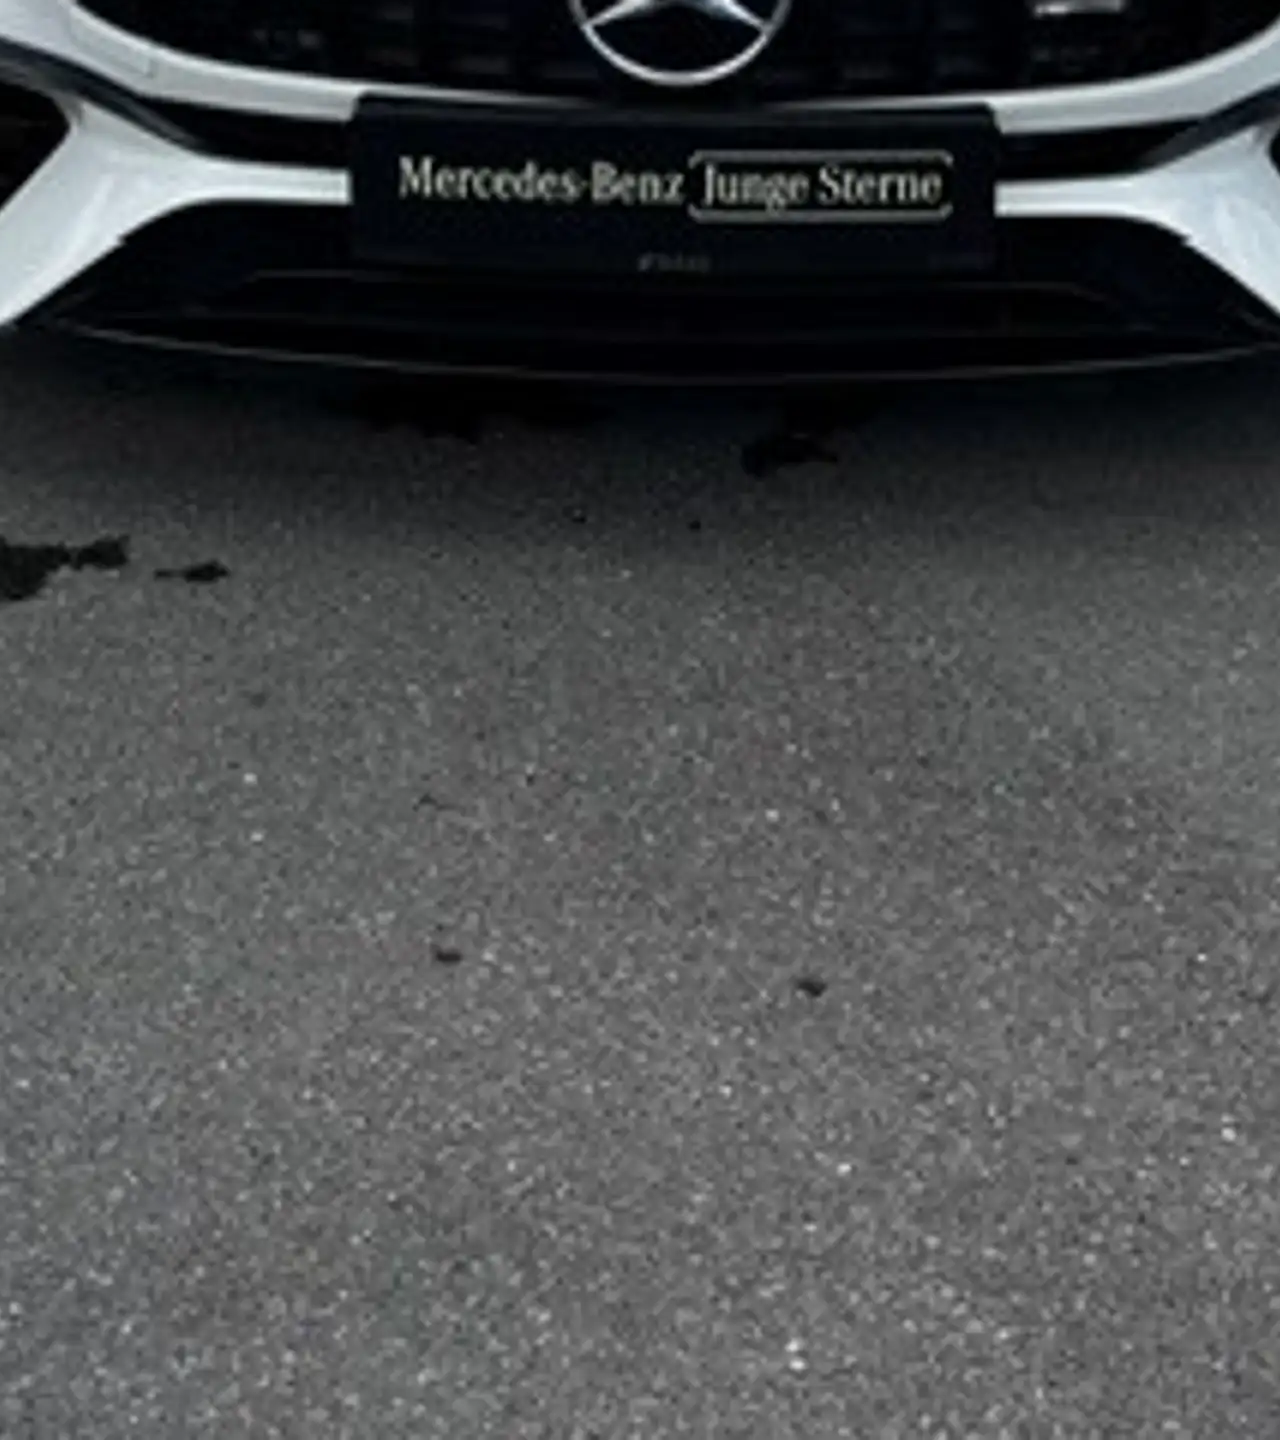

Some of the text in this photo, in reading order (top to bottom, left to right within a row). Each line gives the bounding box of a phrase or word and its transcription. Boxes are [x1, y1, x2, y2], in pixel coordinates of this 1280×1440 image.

[398, 154, 943, 216] Mercedes-Benz Junge Sterne
